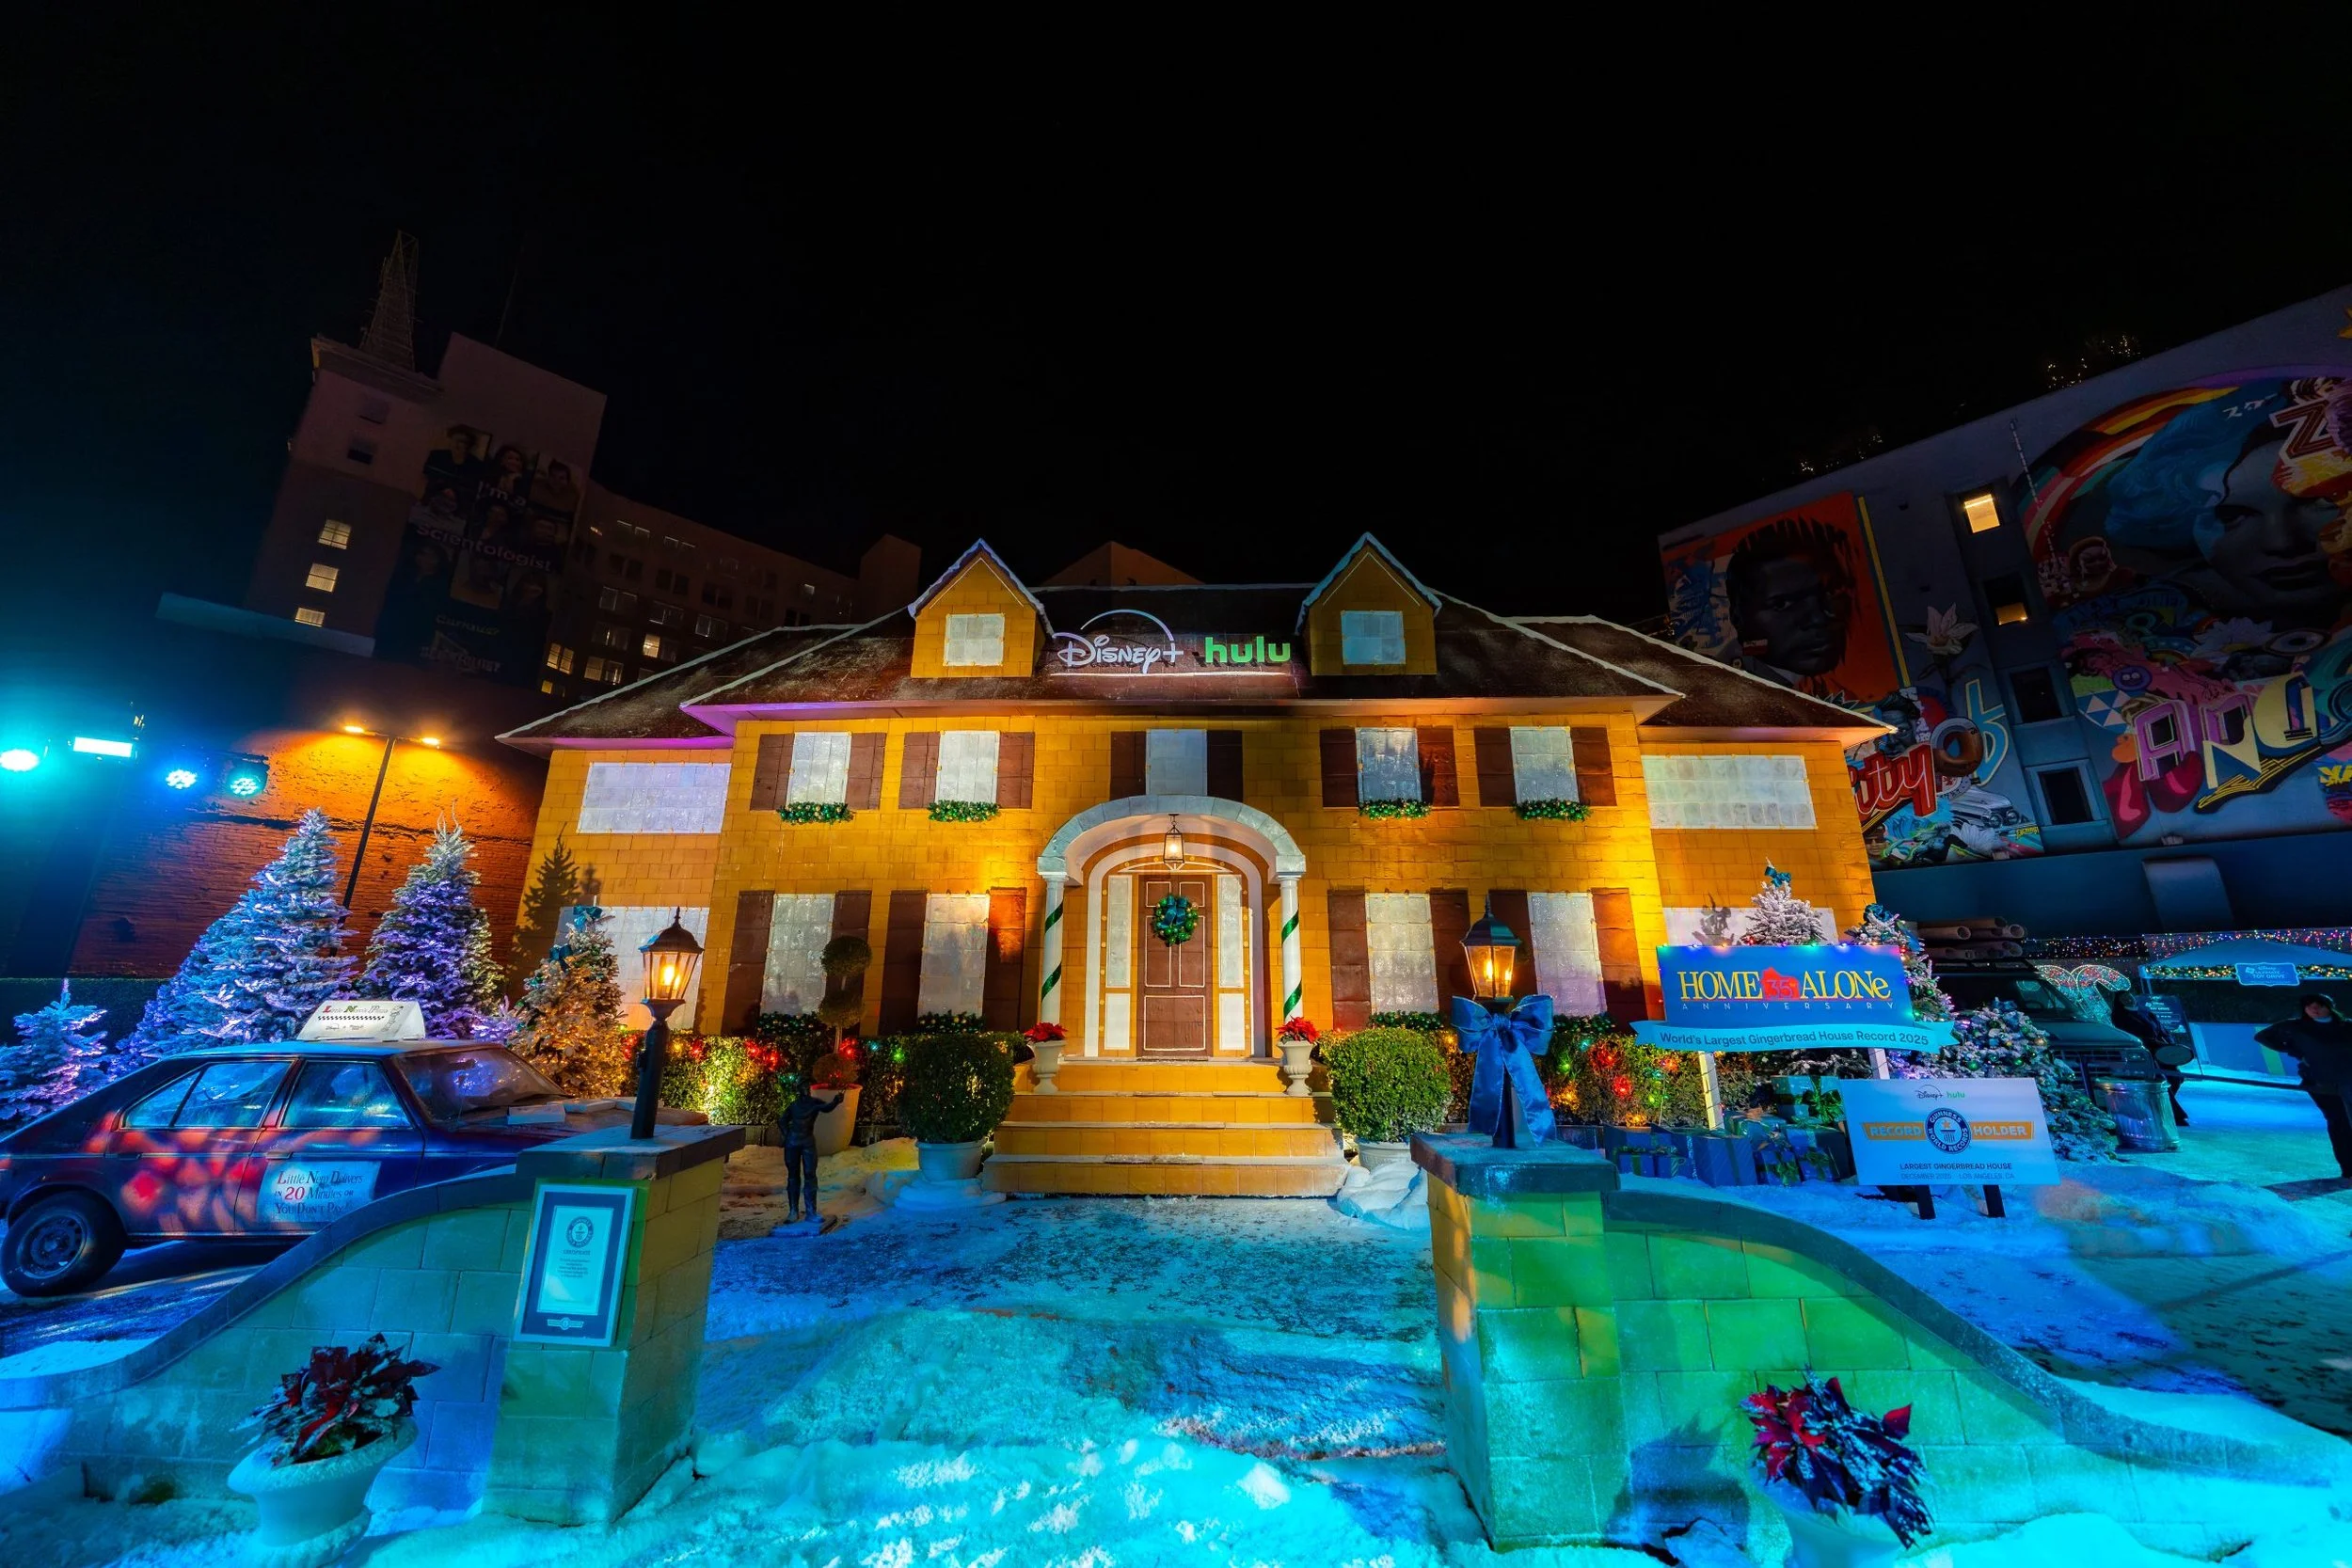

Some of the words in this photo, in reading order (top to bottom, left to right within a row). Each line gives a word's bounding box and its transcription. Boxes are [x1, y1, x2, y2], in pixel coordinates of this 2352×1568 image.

[1205, 636, 1291, 663] hulu
[1677, 970, 1763, 1000] HOME
[1682, 1002, 1894, 1010] ANNIVERSARY
[1660, 1032, 1702, 1045] World's
[1704, 1035, 1747, 1048] Largest
[1748, 1030, 1817, 1046] Gingerbread
[1819, 1031, 1854, 1042] House
[1855, 1030, 1897, 1042] Record
[1899, 1033, 1930, 1046] 2025
[1929, 1110, 1963, 1124] GUINNESS
[1869, 1126, 1921, 1136] RECORD
[1974, 1126, 2027, 1136] HOLDER
[1928, 1128, 1947, 1150] WORLD
[1948, 1127, 1969, 1152] RECORDS
[277, 1170, 305, 1185] Little
[284, 1186, 306, 1200] 20
